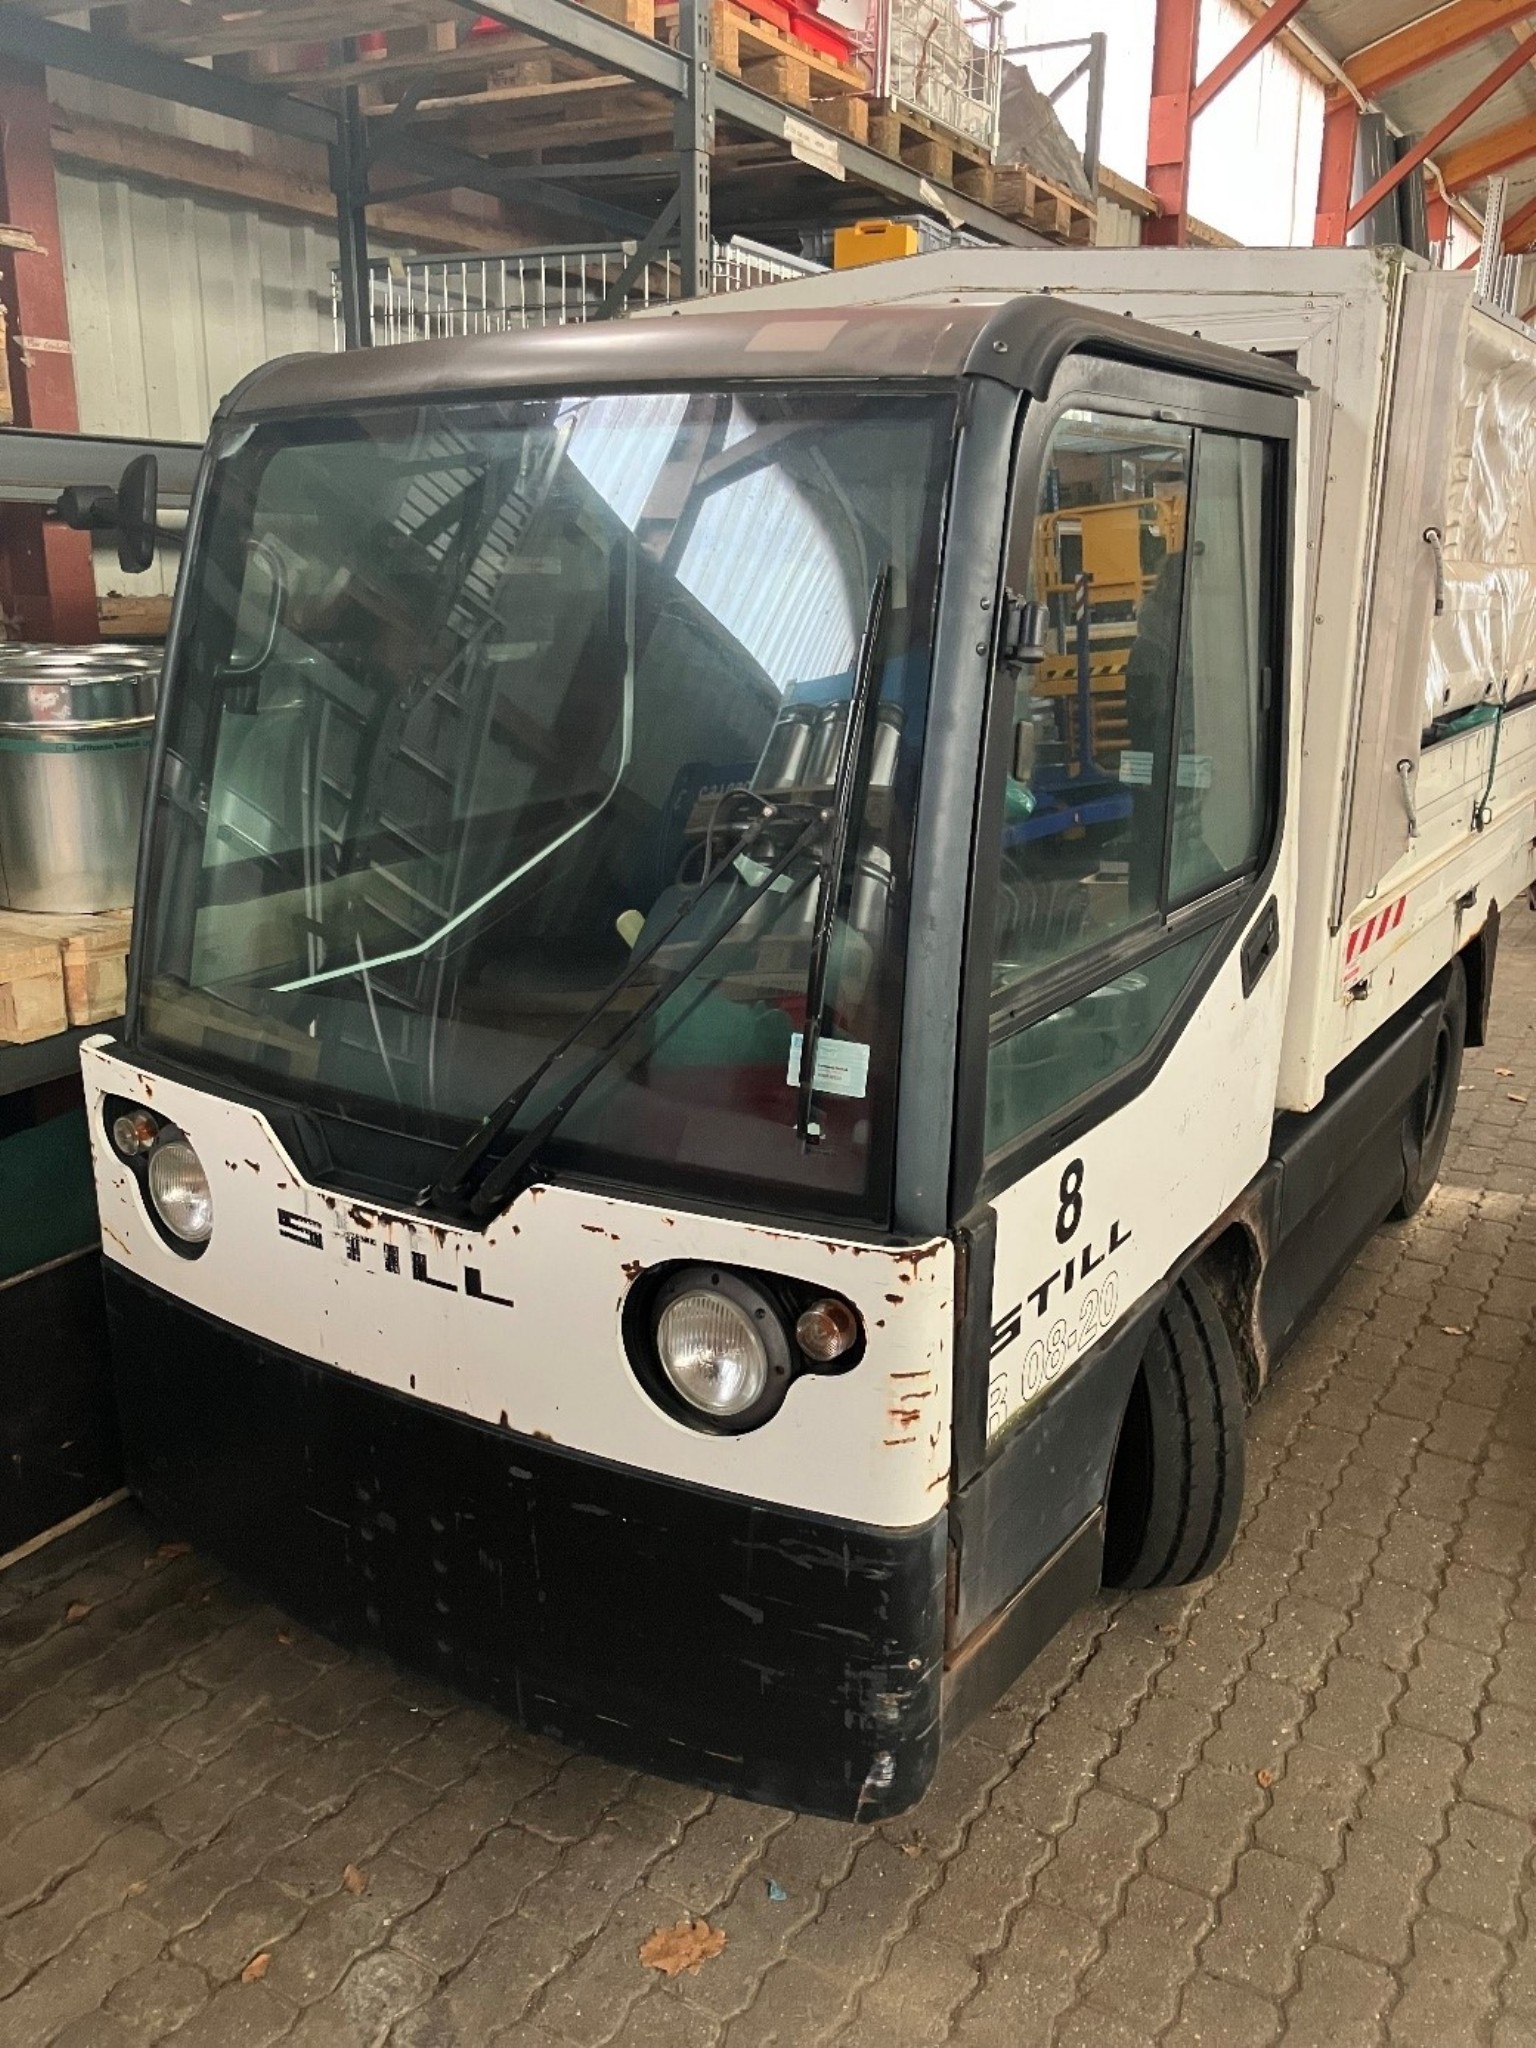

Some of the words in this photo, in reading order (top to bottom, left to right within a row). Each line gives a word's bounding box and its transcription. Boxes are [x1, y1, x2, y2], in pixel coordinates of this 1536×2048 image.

[277, 1207, 515, 1308] STILL
[1055, 1157, 1084, 1244] 8
[990, 1219, 1132, 1362] STILL
[1021, 1269, 1119, 1403] 08-20
